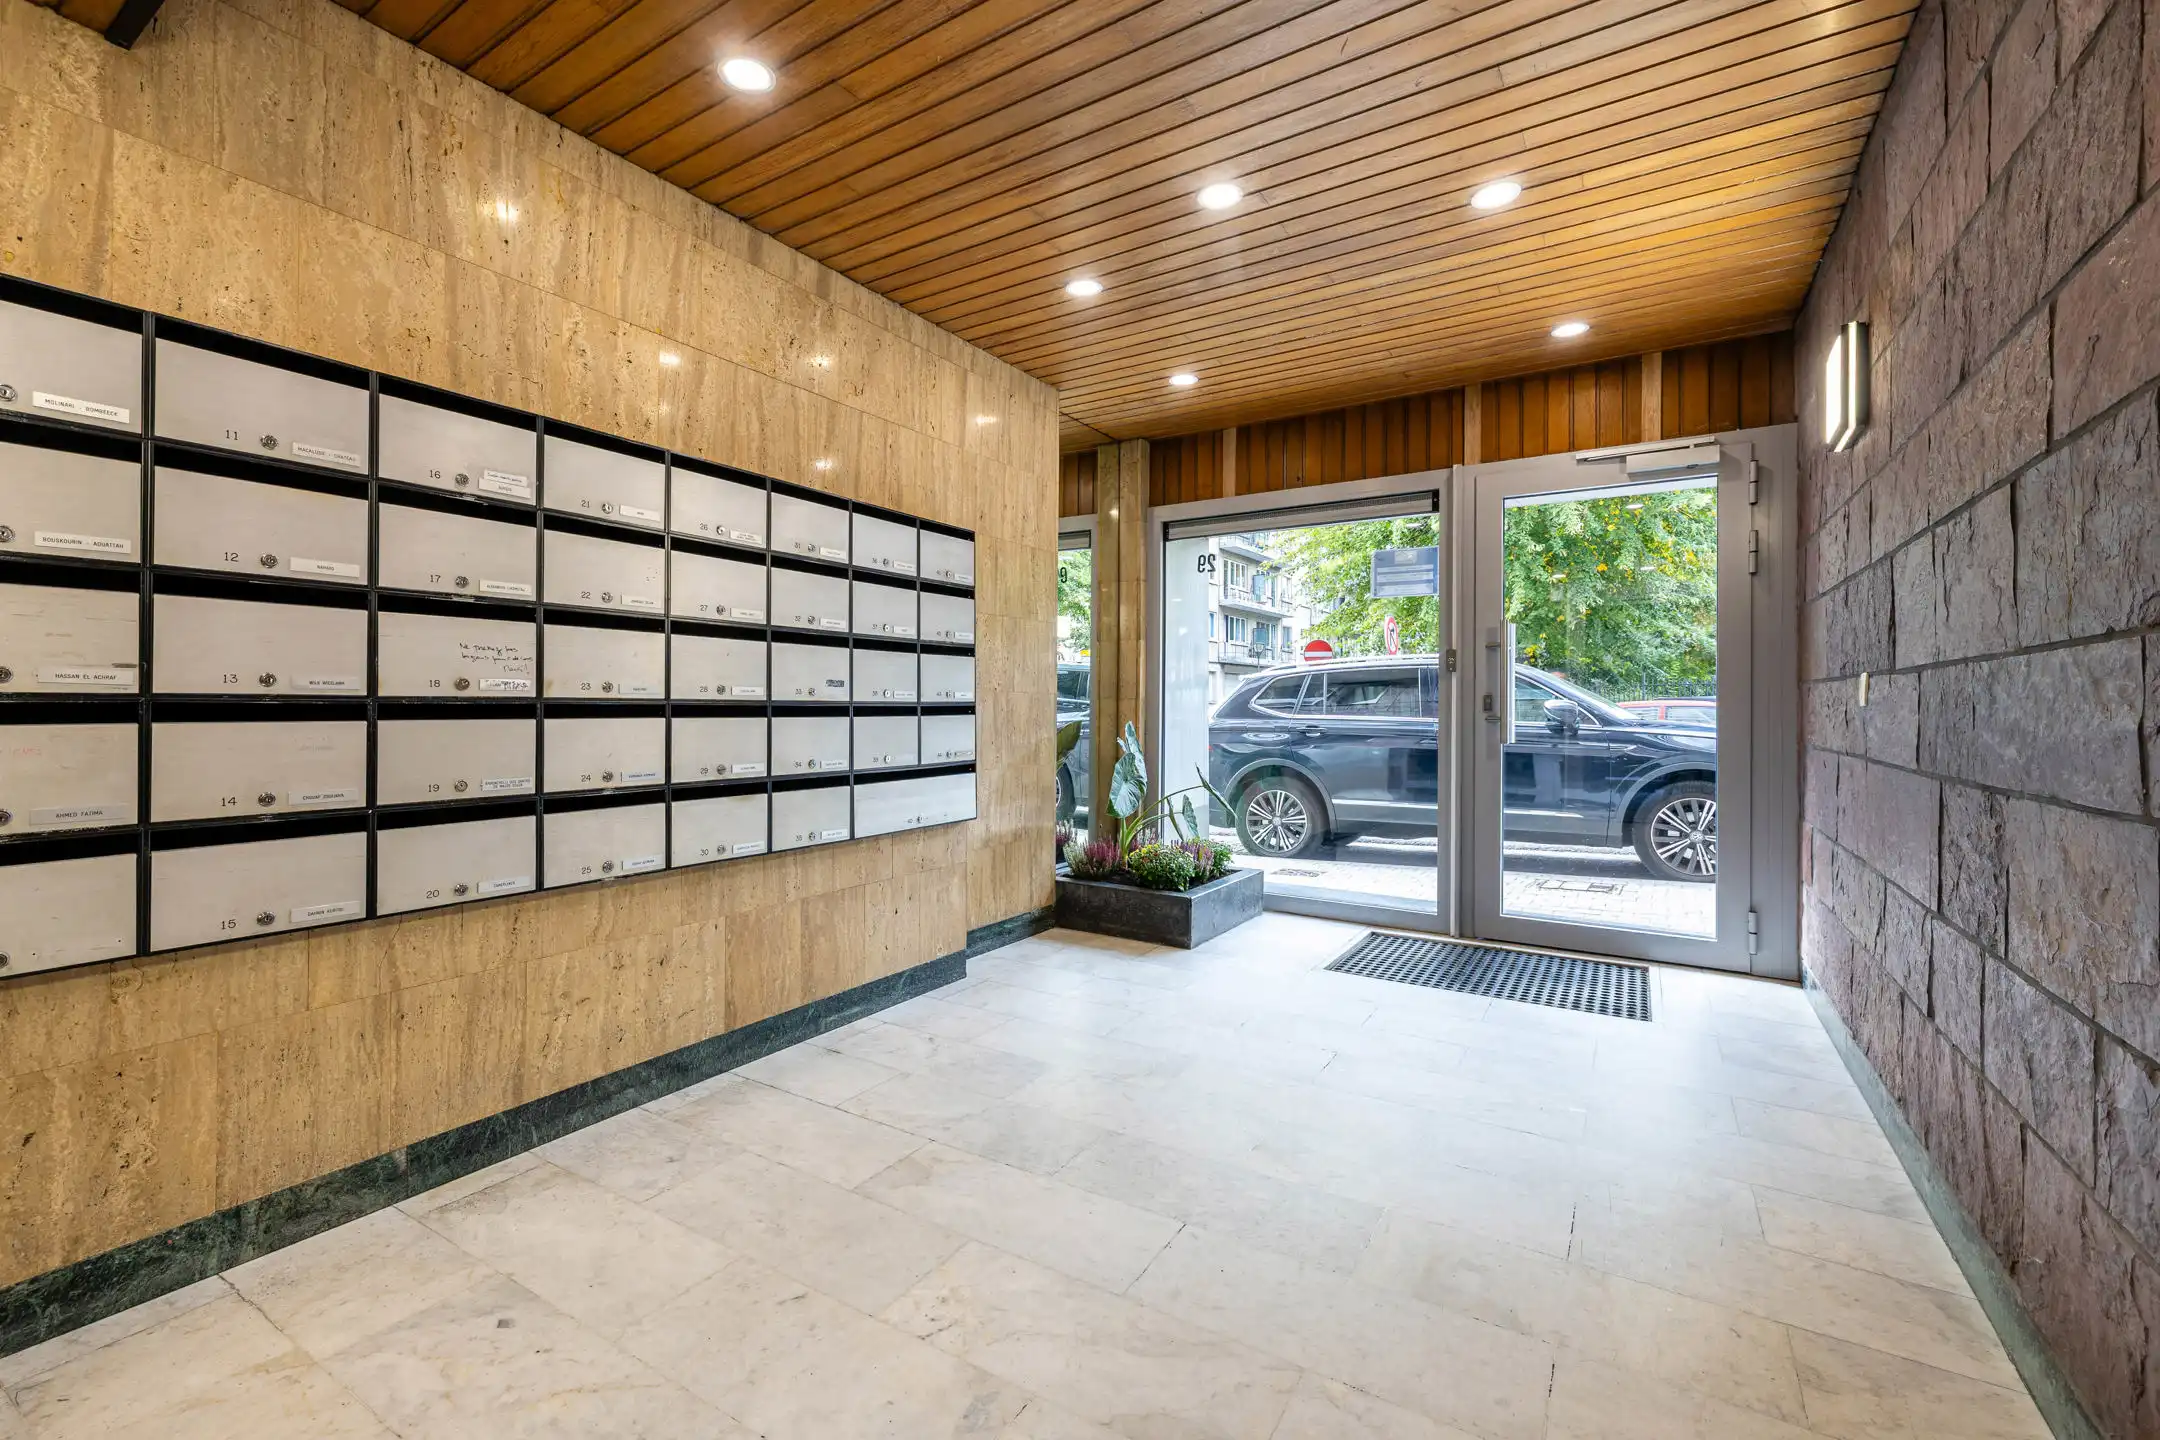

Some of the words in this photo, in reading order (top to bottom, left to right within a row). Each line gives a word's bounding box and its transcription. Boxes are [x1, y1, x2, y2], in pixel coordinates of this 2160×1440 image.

[45, 398, 75, 409] MOLINARI
[225, 429, 238, 441] 11
[429, 469, 441, 479] 16
[581, 499, 590, 509] 21
[699, 522, 708, 531] 26
[224, 551, 239, 563] 12
[429, 574, 441, 583] 17
[581, 591, 591, 599] 22
[699, 604, 708, 612] 27
[55, 672, 80, 680] HASSAN
[223, 673, 238, 684] 13
[429, 679, 441, 688] 18
[581, 682, 591, 691] 23
[699, 685, 709, 693] 28
[700, 767, 709, 775] 29
[581, 774, 592, 783] 24
[428, 784, 440, 793] 19
[221, 796, 238, 807] 14
[700, 848, 709, 857] 30
[581, 866, 592, 875] 25
[426, 889, 440, 899] 20
[221, 919, 237, 930] 15
